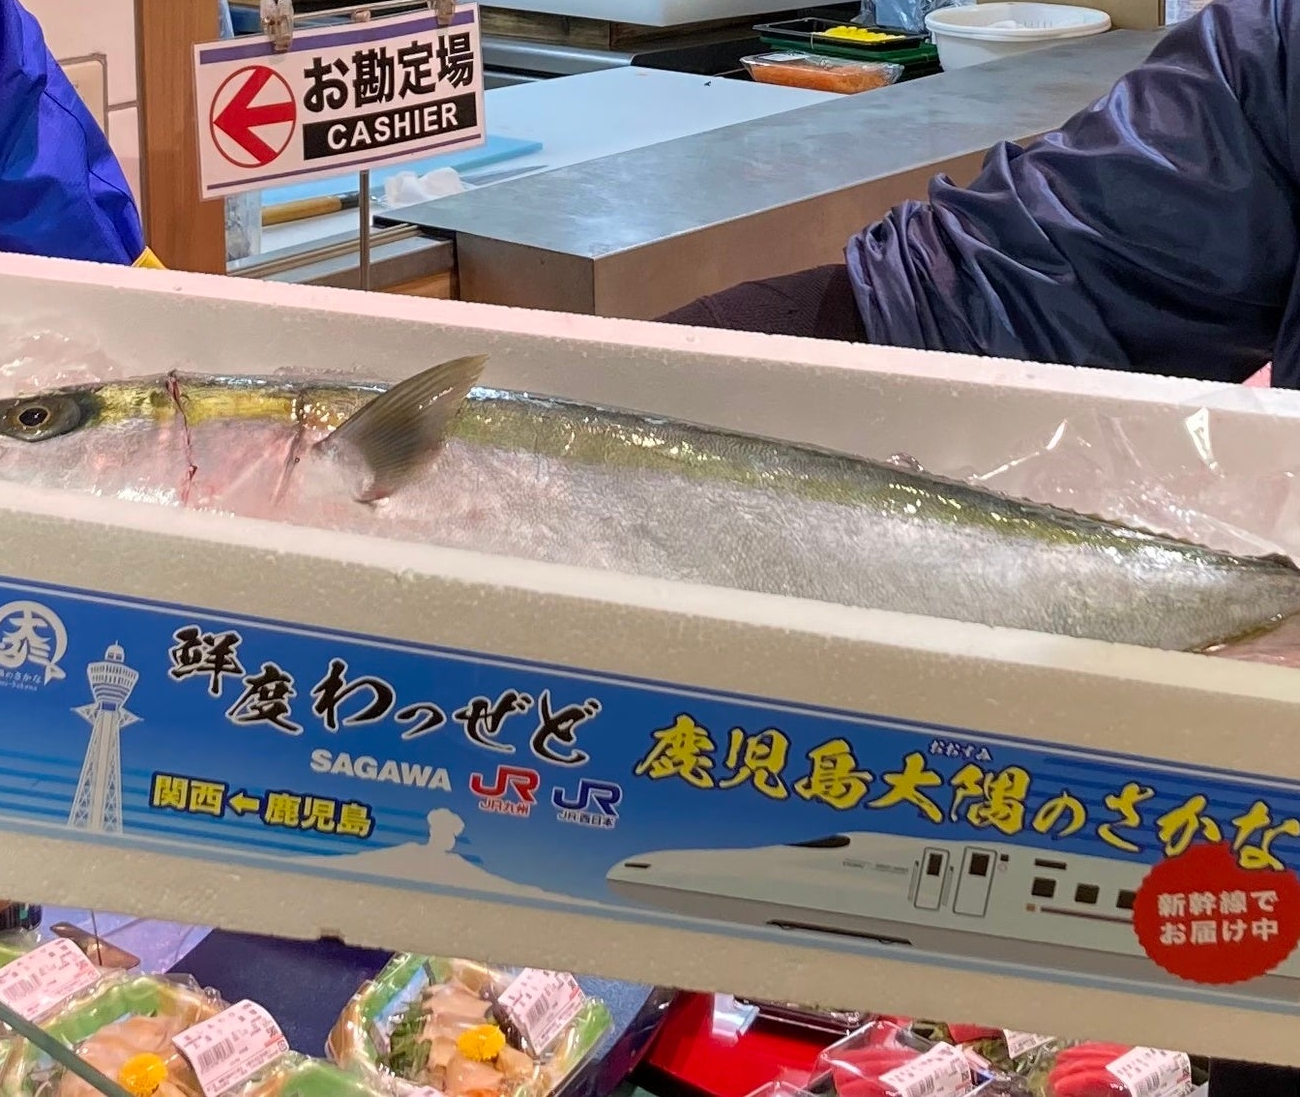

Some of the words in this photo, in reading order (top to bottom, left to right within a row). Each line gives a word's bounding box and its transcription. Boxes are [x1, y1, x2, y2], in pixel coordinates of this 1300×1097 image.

[303, 31, 474, 113] お勘定場
[327, 102, 458, 150] CASHIER
[170, 625, 602, 768] 鮮度わっぜど
[310, 749, 452, 791] SAGAWA
[469, 764, 540, 804] JR
[153, 773, 224, 815] 関西
[265, 791, 373, 836] 鹿児島
[479, 798, 530, 818] JR九州
[551, 778, 623, 818] JR
[557, 810, 616, 830] JR西日本
[1157, 889, 1279, 917] 新幹線で
[1159, 917, 1280, 946] お届け中
